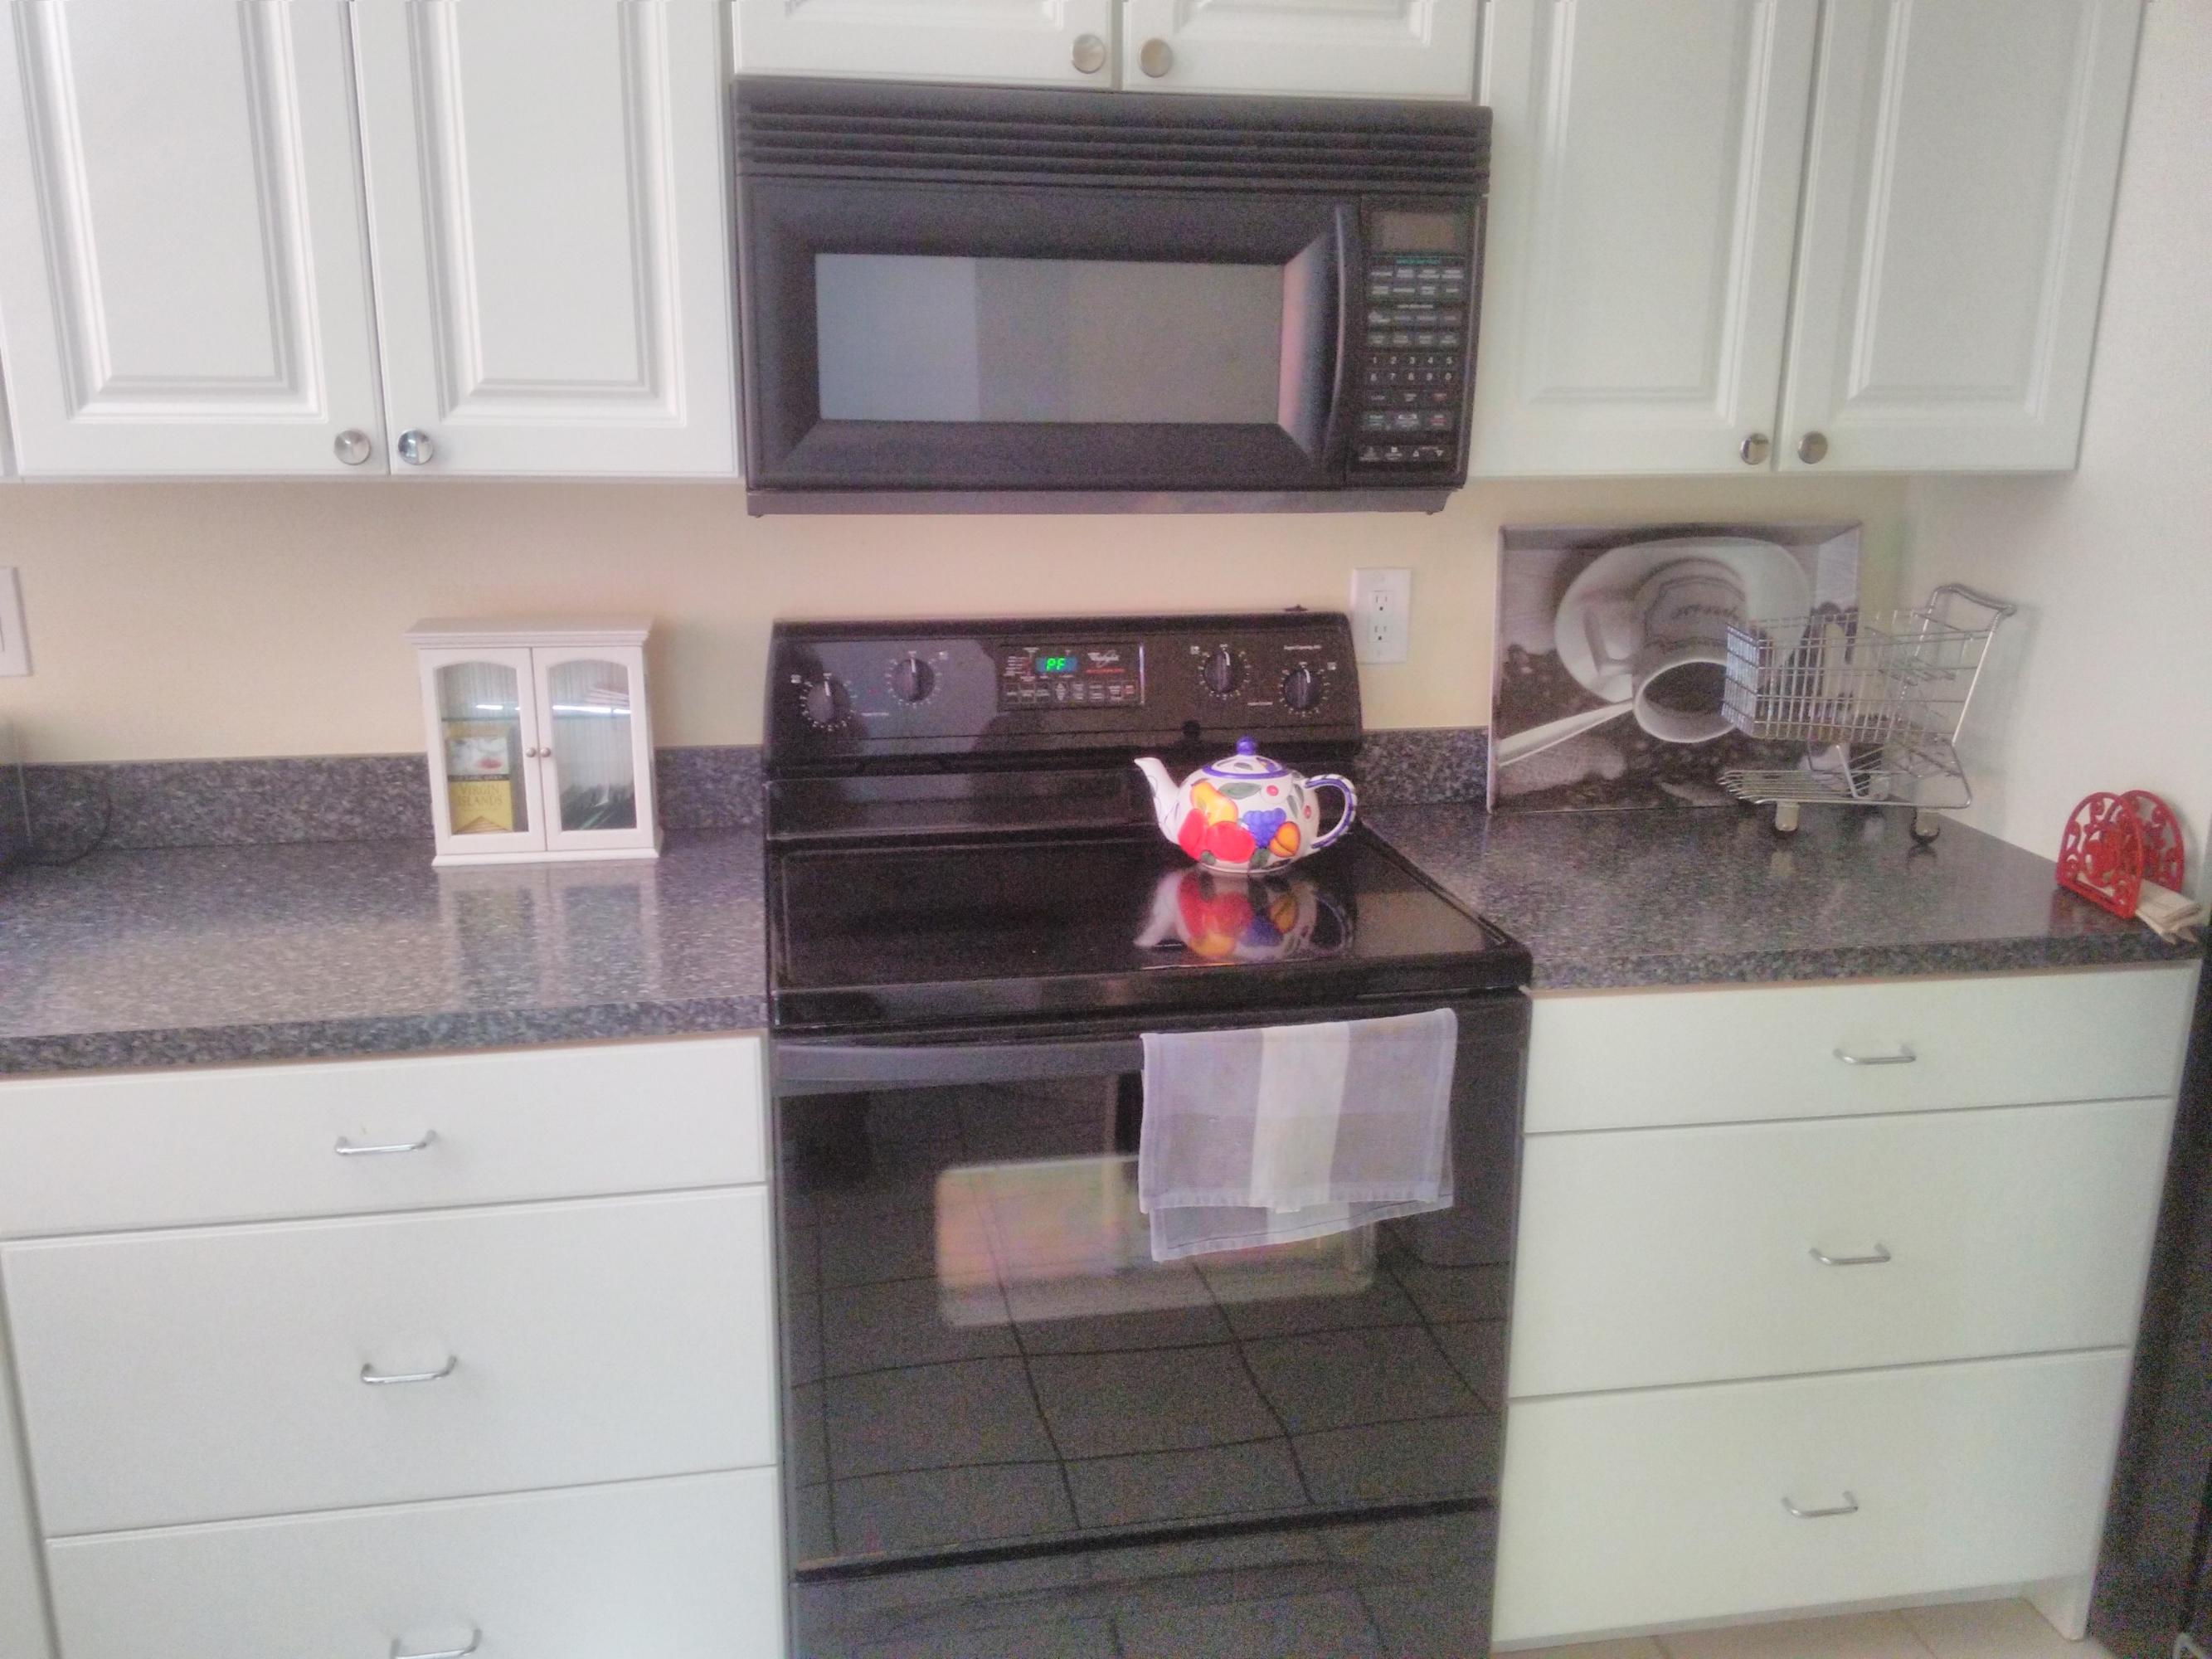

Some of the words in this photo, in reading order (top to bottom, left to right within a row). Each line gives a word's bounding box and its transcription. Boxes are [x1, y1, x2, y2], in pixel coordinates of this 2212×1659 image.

[1047, 657, 1067, 671] PF
[460, 783, 500, 795] VIRGIN
[458, 795, 503, 806] ISLANDS
